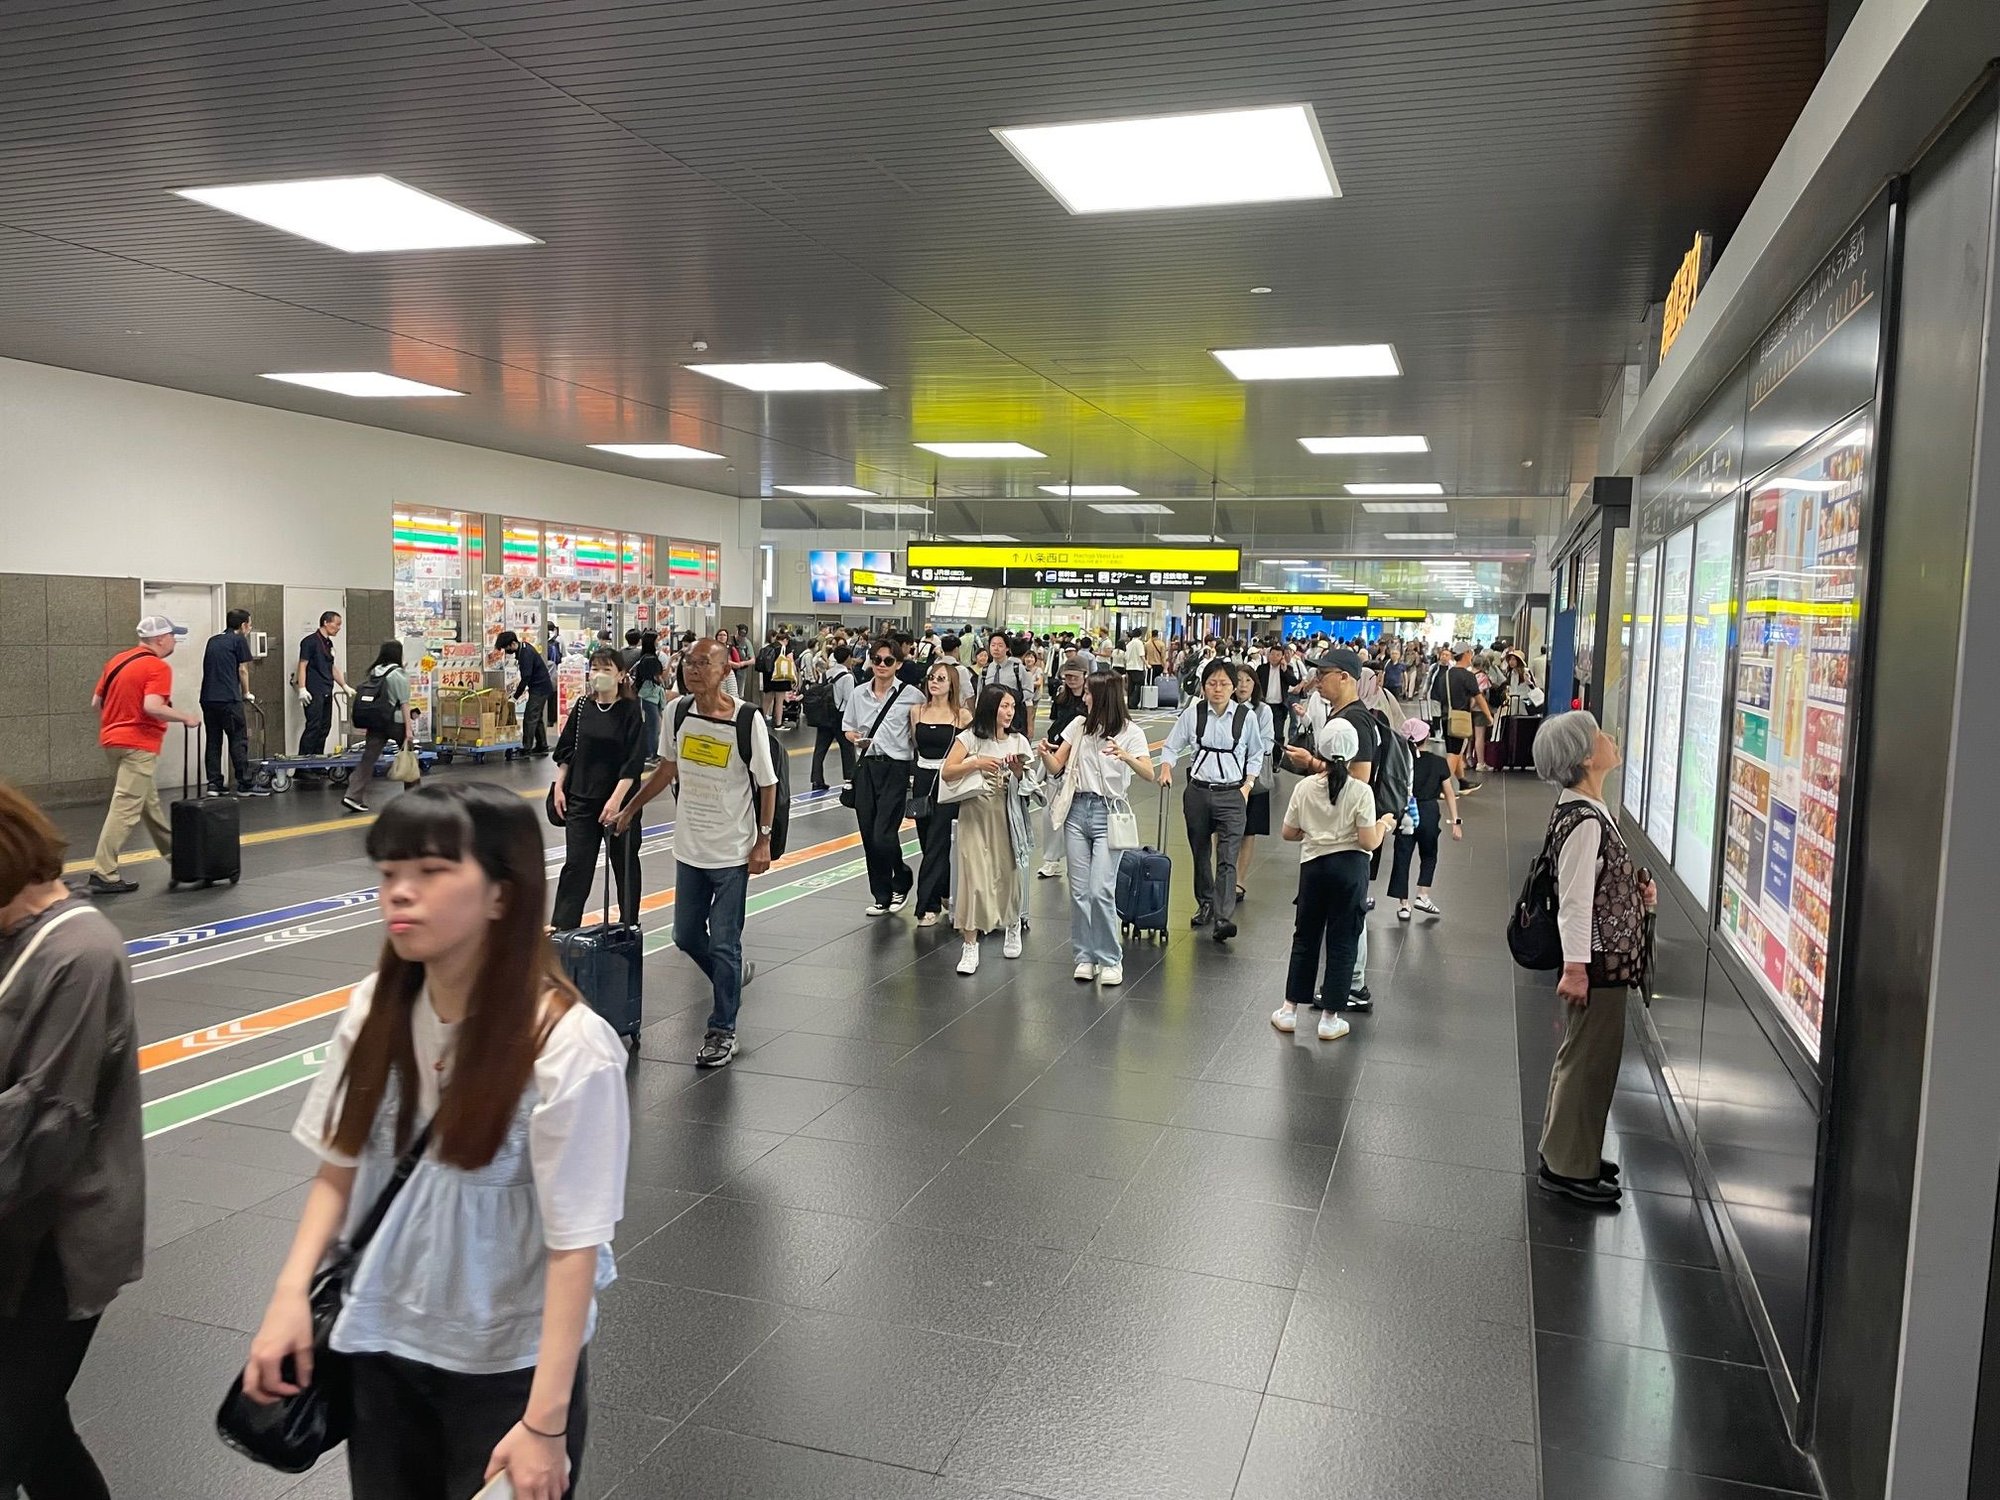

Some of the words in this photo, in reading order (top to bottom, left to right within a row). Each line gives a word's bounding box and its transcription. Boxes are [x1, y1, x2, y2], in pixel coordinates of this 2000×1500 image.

[1825, 268, 1868, 331] GUIDE
[1023, 552, 1069, 564] 八条西口
